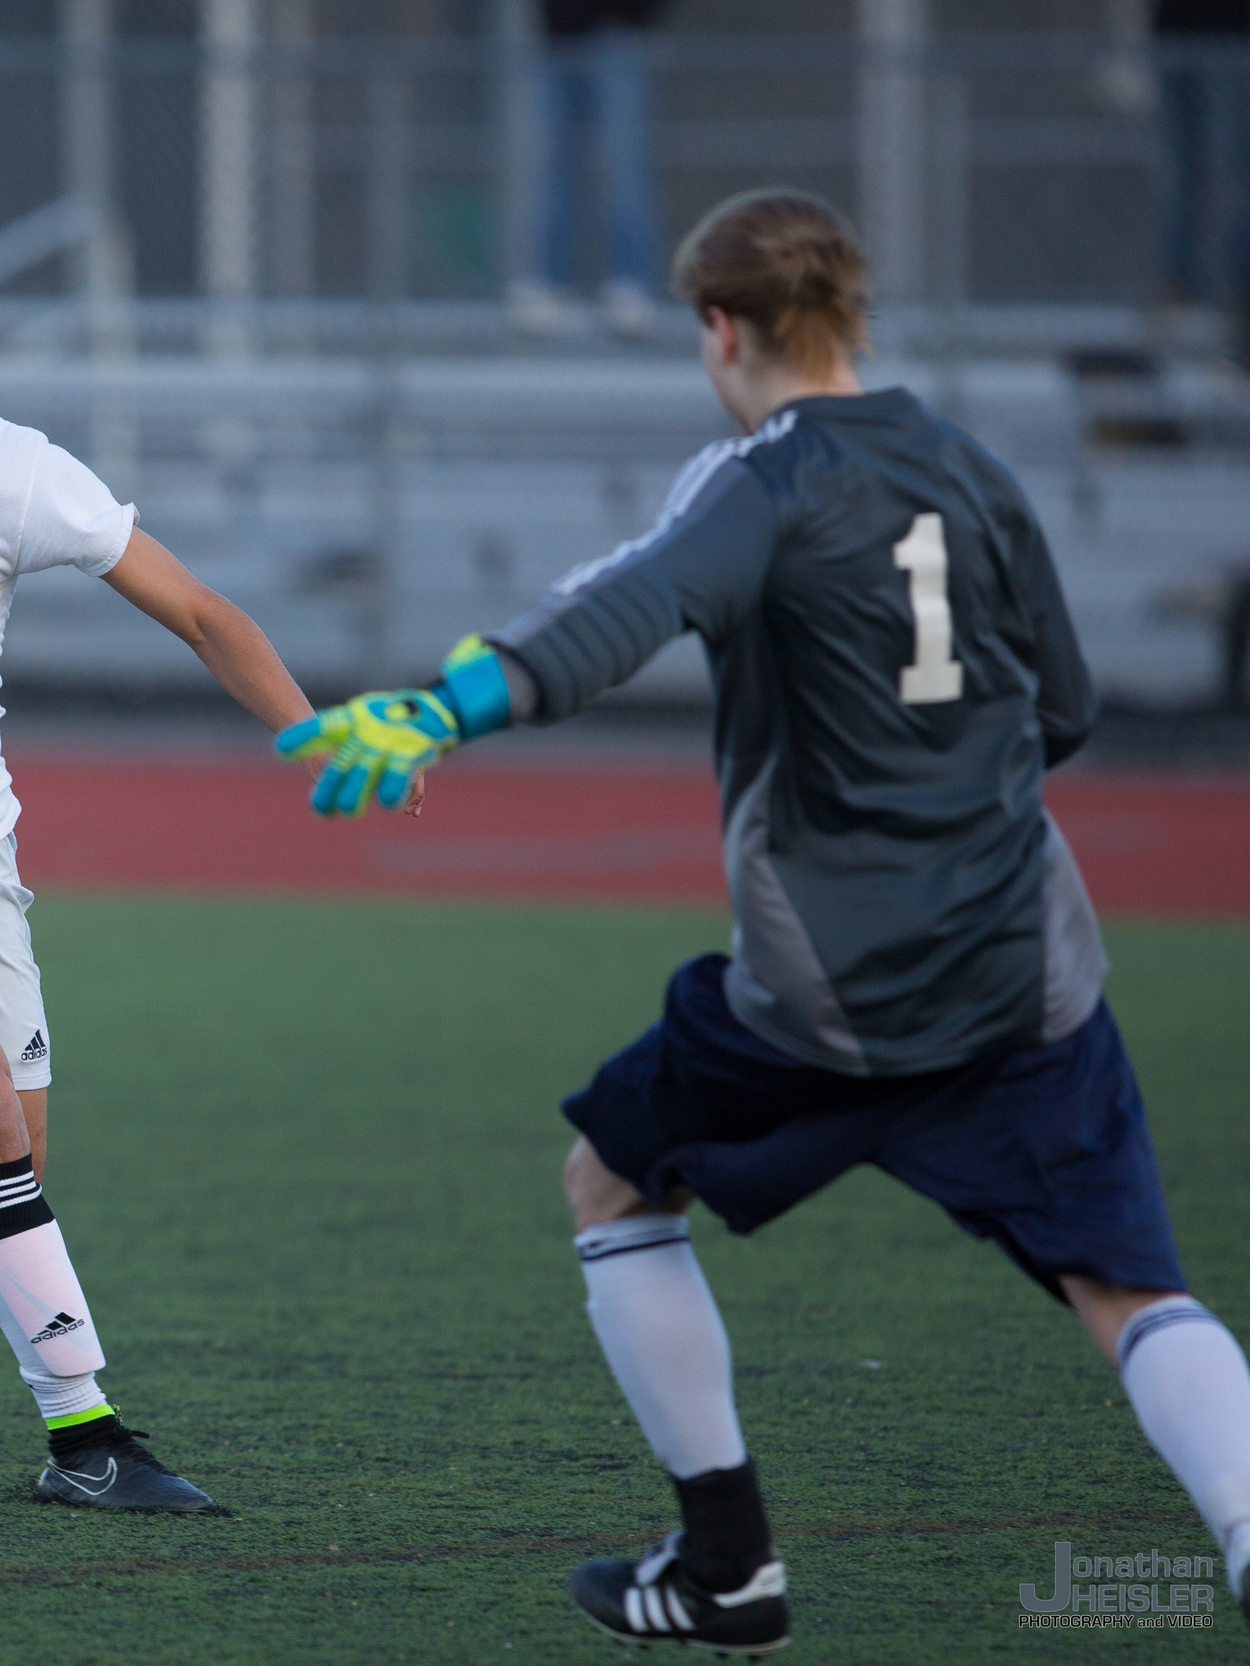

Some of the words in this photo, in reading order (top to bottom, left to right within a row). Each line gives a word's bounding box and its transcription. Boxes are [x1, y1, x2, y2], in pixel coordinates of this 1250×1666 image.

[892, 512, 964, 705] 1
[21, 1047, 48, 1061] adidas
[31, 1319, 85, 1343] adidas
